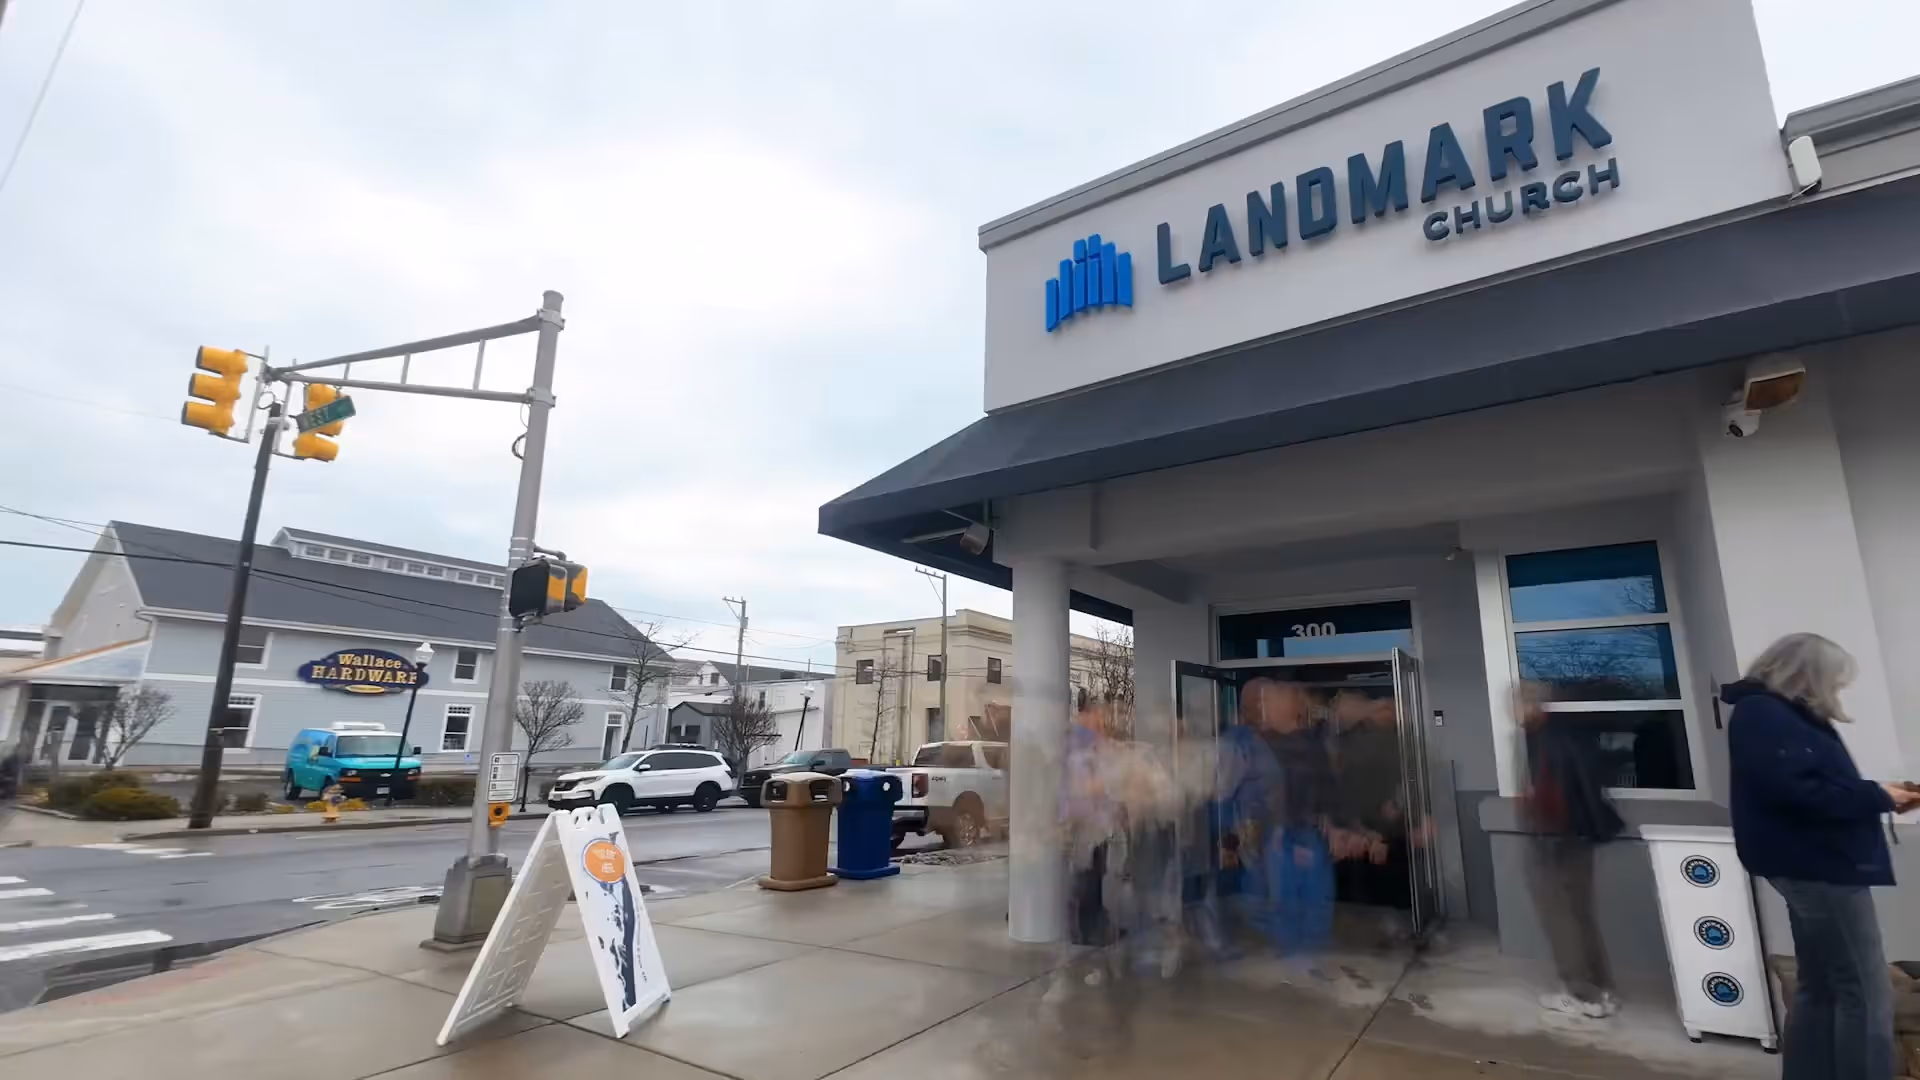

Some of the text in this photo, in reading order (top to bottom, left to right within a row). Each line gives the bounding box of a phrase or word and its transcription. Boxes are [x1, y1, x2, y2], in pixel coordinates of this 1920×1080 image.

[1157, 67, 1613, 285] LANDMARK
[1422, 157, 1620, 241] CHURCH
[312, 665, 418, 685] HARDWARE
[338, 654, 402, 669] Wallace
